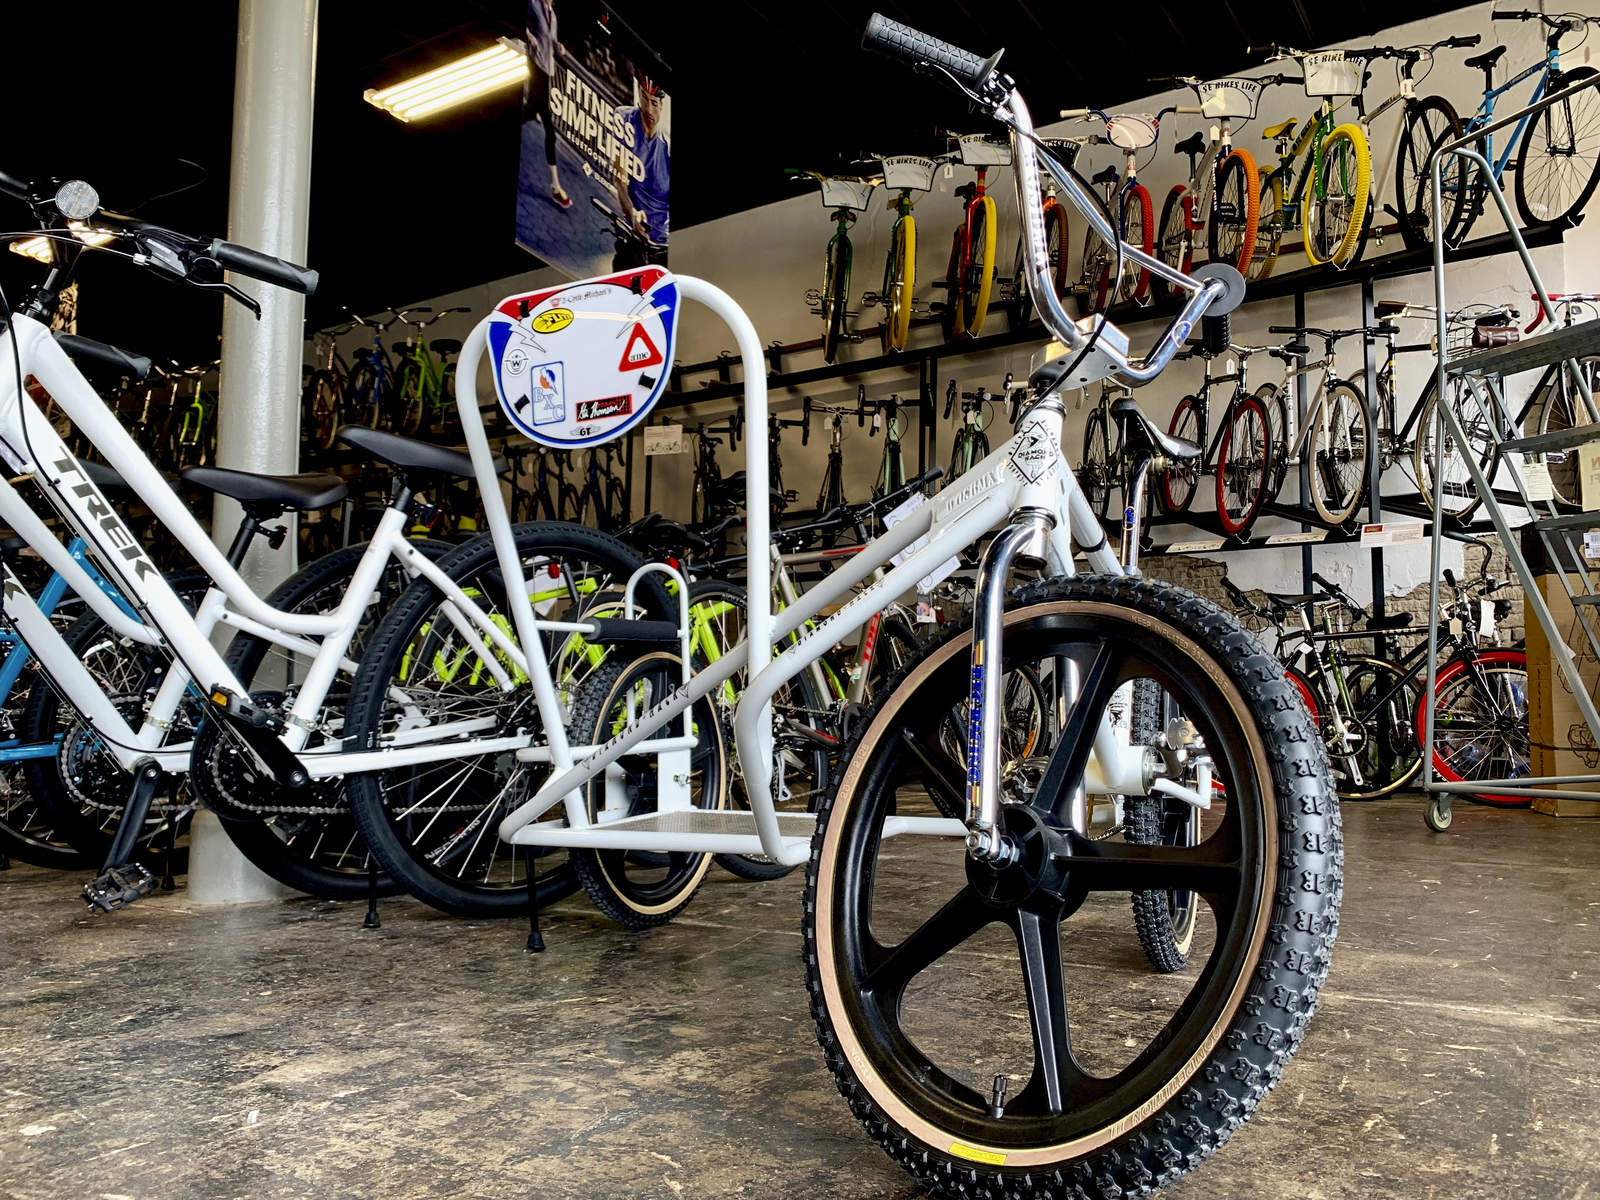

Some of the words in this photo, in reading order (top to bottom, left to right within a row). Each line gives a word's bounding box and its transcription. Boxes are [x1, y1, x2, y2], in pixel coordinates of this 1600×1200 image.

[566, 69, 635, 148] FITNESS
[1202, 84, 1213, 93] SE
[1215, 80, 1239, 90] BIKES
[1241, 82, 1258, 93] LIFE
[550, 87, 646, 183] SIMPLIFIED
[566, 130, 608, 165] BLUETOOTH
[919, 159, 933, 169] LIFE
[579, 427, 591, 436] GT
[53, 445, 160, 583] TREK
[1129, 1024, 1225, 1124] COMPETITION
